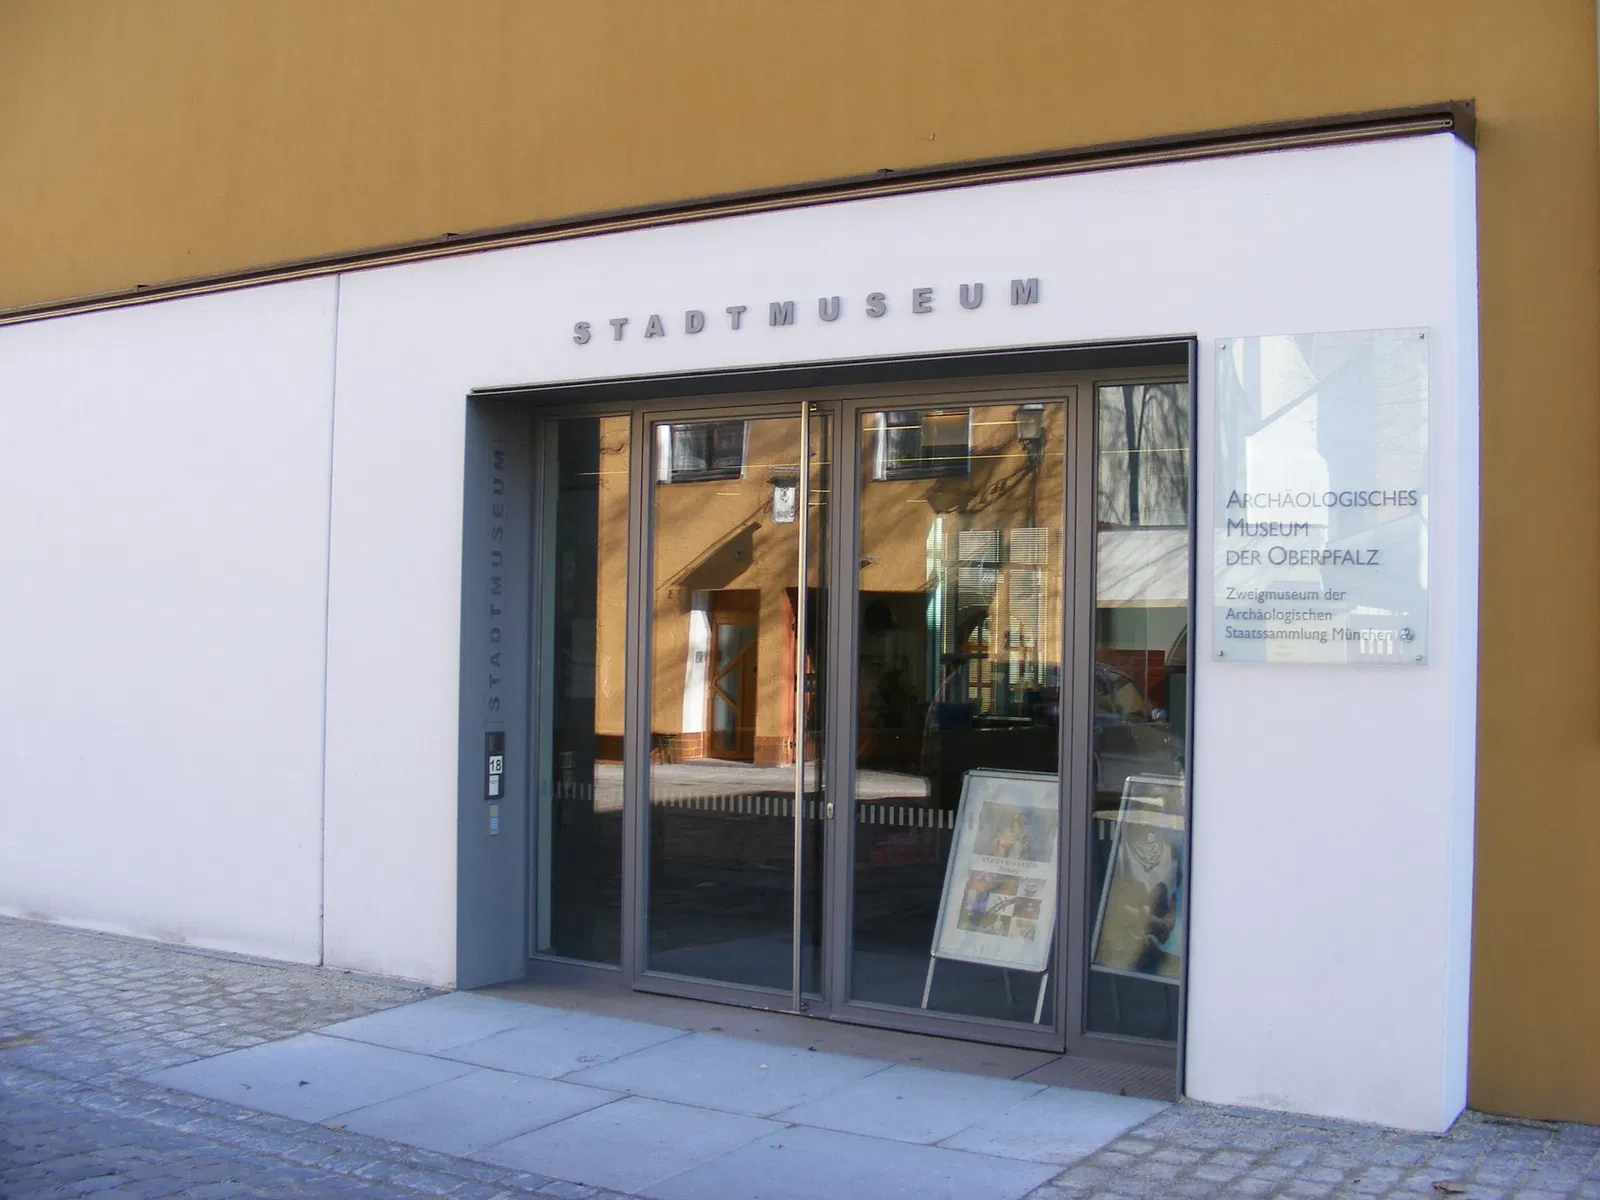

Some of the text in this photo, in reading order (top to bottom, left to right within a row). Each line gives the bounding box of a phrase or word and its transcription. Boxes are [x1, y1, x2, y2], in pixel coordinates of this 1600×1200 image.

[573, 277, 1040, 345] STADTMUSEUM
[1226, 546, 1380, 565] DER OBERPFALZ
[488, 450, 506, 712] STADTMUSEUM
[1226, 588, 1347, 603] Zweigmuseum der
[1225, 608, 1333, 623] Archäologischen
[1225, 626, 1393, 643] Staatssammlung München
[490, 760, 502, 771] 18
